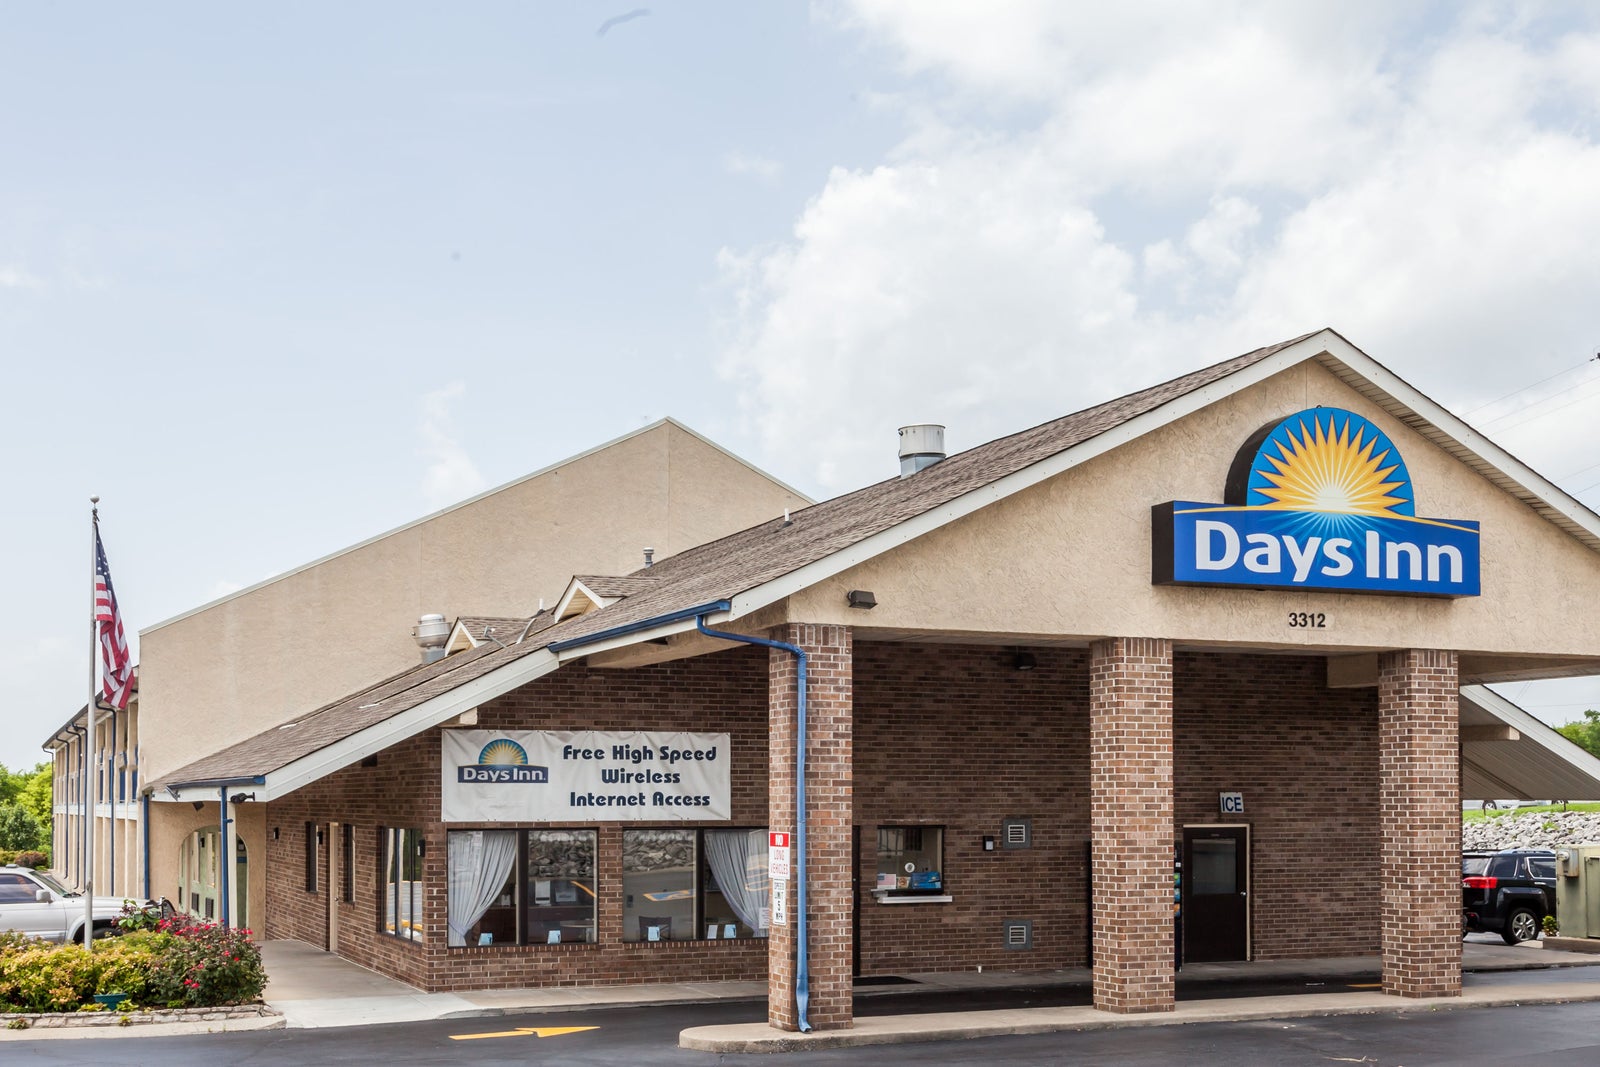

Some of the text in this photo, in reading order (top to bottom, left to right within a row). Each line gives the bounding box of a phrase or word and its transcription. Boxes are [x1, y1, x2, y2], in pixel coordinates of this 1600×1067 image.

[1195, 519, 1463, 583] Days Inn
[1288, 612, 1327, 628] 3312
[563, 744, 717, 764] Free High Speed
[463, 767, 544, 782] Days Inn
[601, 768, 681, 784] Wireless
[570, 791, 711, 807] Internet Access
[1221, 796, 1242, 812] ICE
[775, 834, 784, 846] NO
